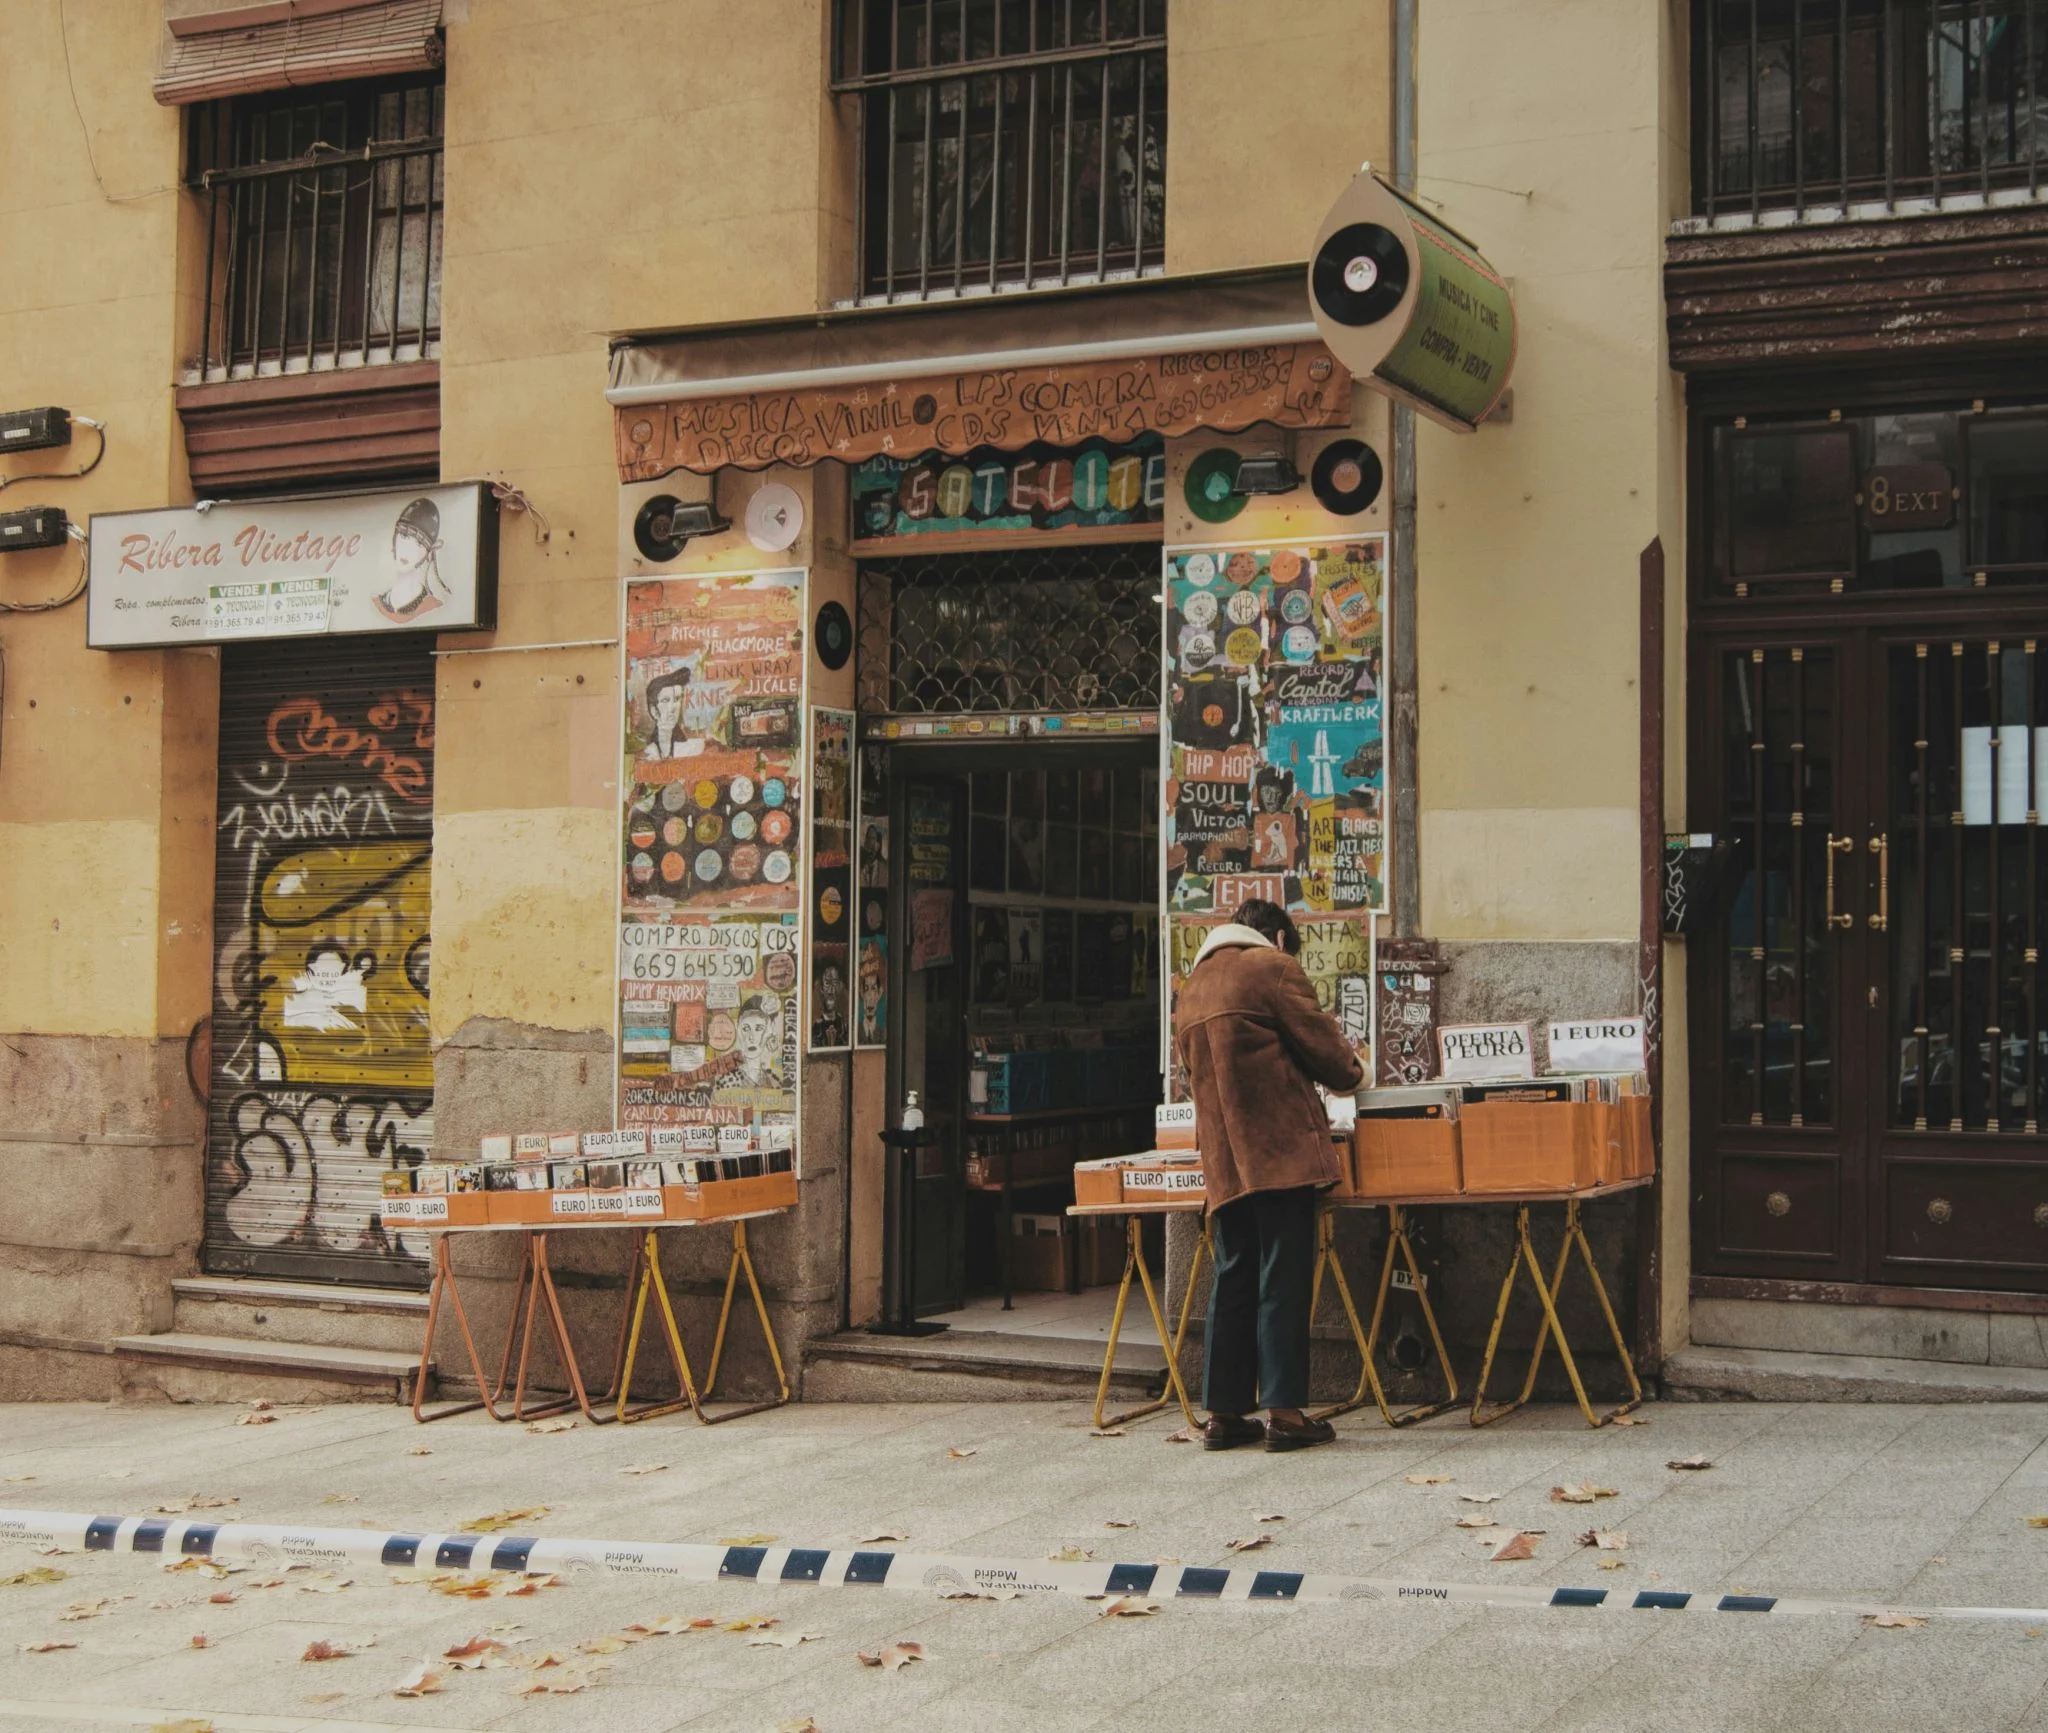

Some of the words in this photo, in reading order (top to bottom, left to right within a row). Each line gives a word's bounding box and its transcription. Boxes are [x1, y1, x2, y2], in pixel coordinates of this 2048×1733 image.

[1160, 346, 1278, 377] RECORDS
[1020, 372, 1156, 413] COMPRA
[698, 426, 817, 467] DISCOS
[1033, 406, 1146, 443] VENTA
[905, 453, 1166, 518] SATELITE
[1871, 476, 1889, 515] 8
[1895, 491, 1942, 512] EXT
[118, 529, 224, 574] Ribera
[234, 524, 362, 573] Vintage
[218, 584, 260, 597] VENDE
[279, 580, 320, 592] VENDE
[169, 615, 201, 629] Ribera
[671, 625, 721, 641] RITCHIE
[711, 636, 786, 654] BLACKMORE
[752, 658, 792, 675] WRAY
[1299, 663, 1351, 678] RECORDS
[1278, 668, 1355, 700] Capitol
[1280, 703, 1381, 724] KRAFTWERK
[1186, 753, 1213, 775] HIP
[1221, 755, 1254, 778] HOP
[1181, 782, 1245, 806] SOUL
[1191, 808, 1246, 829] VICTOR
[1313, 838, 1334, 853] THE
[1334, 839, 1361, 856] JAZZ
[1355, 856, 1367, 869] A
[1221, 880, 1273, 906] EMI
[1312, 882, 1326, 897] IN
[622, 927, 701, 946] COMPRO
[709, 927, 760, 948] DISCOS
[766, 928, 799, 952] CDS
[1299, 921, 1355, 944] ENTA
[634, 953, 676, 978] 669
[683, 950, 718, 978] 645
[723, 950, 754, 977] 590
[624, 982, 654, 1001] JIMMY
[656, 984, 706, 1002] HENDRIX
[1343, 981, 1364, 1039] JAZZ
[1444, 1030, 1523, 1048] OFERTA
[1569, 1024, 1636, 1040] EURO
[1461, 1042, 1524, 1059] EURO
[623, 1105, 669, 1122] CARLOS
[675, 1106, 738, 1124] SANTANA
[1166, 1108, 1193, 1121] EURO
[591, 1133, 613, 1146] EURO
[621, 1130, 645, 1143] EURO
[659, 1131, 683, 1144] EURO
[690, 1127, 715, 1140] EURO
[725, 1128, 749, 1141] EURO
[524, 1136, 547, 1149] EURO
[1134, 1172, 1163, 1186] EURO
[1175, 1173, 1206, 1188] EURO
[388, 1202, 411, 1214] EURO
[561, 1200, 586, 1212] EURO
[598, 1197, 623, 1210] EURO
[635, 1194, 661, 1208] EURO
[422, 1203, 446, 1215] EURO
[281, 1536, 316, 1547] Madrid
[282, 1547, 347, 1557] MUNICIPAL
[605, 1552, 644, 1564] Madrid
[607, 1563, 679, 1576] MUNICIPAL
[974, 1569, 1018, 1581] Madrid
[1399, 1587, 1448, 1599] Madrid
